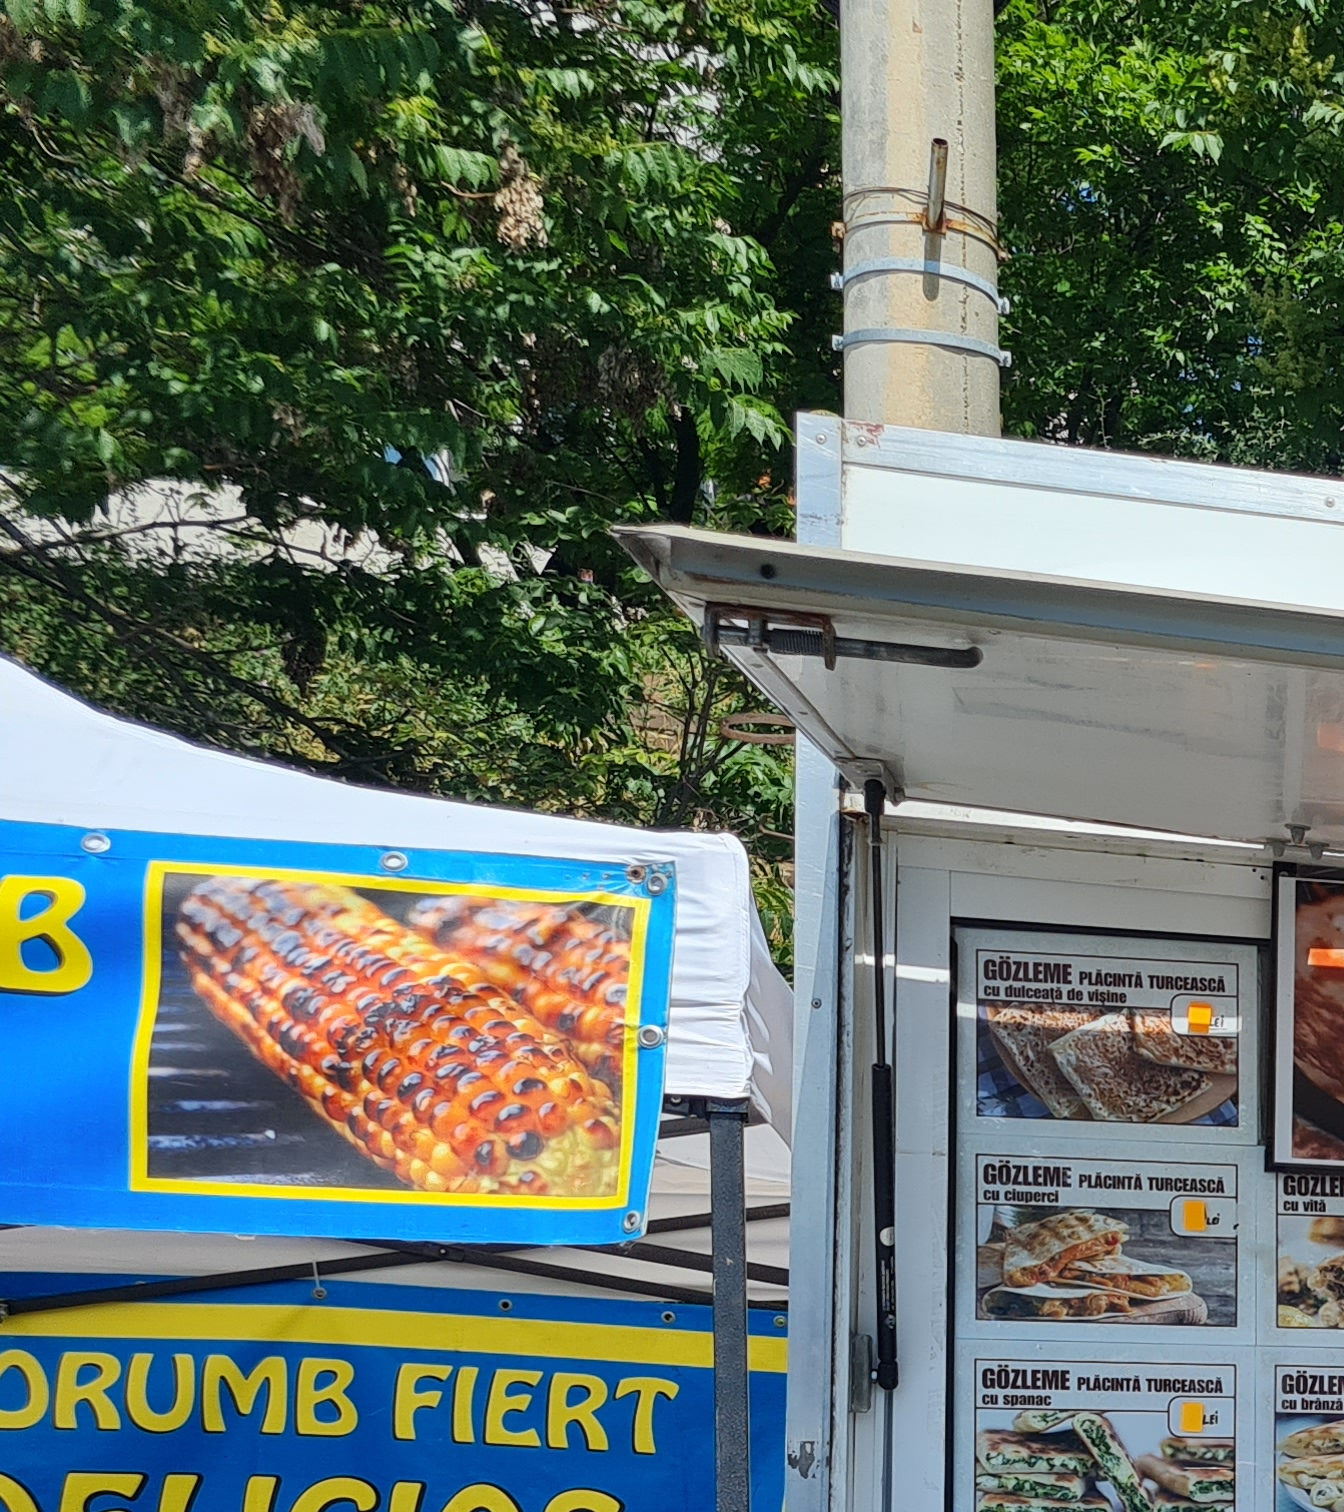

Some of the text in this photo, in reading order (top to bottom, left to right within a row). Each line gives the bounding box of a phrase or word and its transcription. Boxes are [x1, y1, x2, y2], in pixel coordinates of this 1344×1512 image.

[984, 956, 1225, 992] GÖZLEME PLĂCINTĂ TURCEASCĂ
[984, 986, 1000, 997] cu
[1067, 988, 1083, 1000] de
[983, 1160, 1225, 1194] GÖZLEME PLĂCINTĂ TURCEASCĂ
[983, 1189, 1059, 1204] cu ciuperci
[1283, 1199, 1326, 1212] cu vită
[982, 1365, 1223, 1394] GÖZLEME PLĂCINTĂ TURCEASCĂ
[982, 1394, 1052, 1407] cu spanac
[1281, 1399, 1297, 1410] cu
[1301, 1398, 1343, 1411] brânză
[392, 1362, 681, 1456] FIERT
